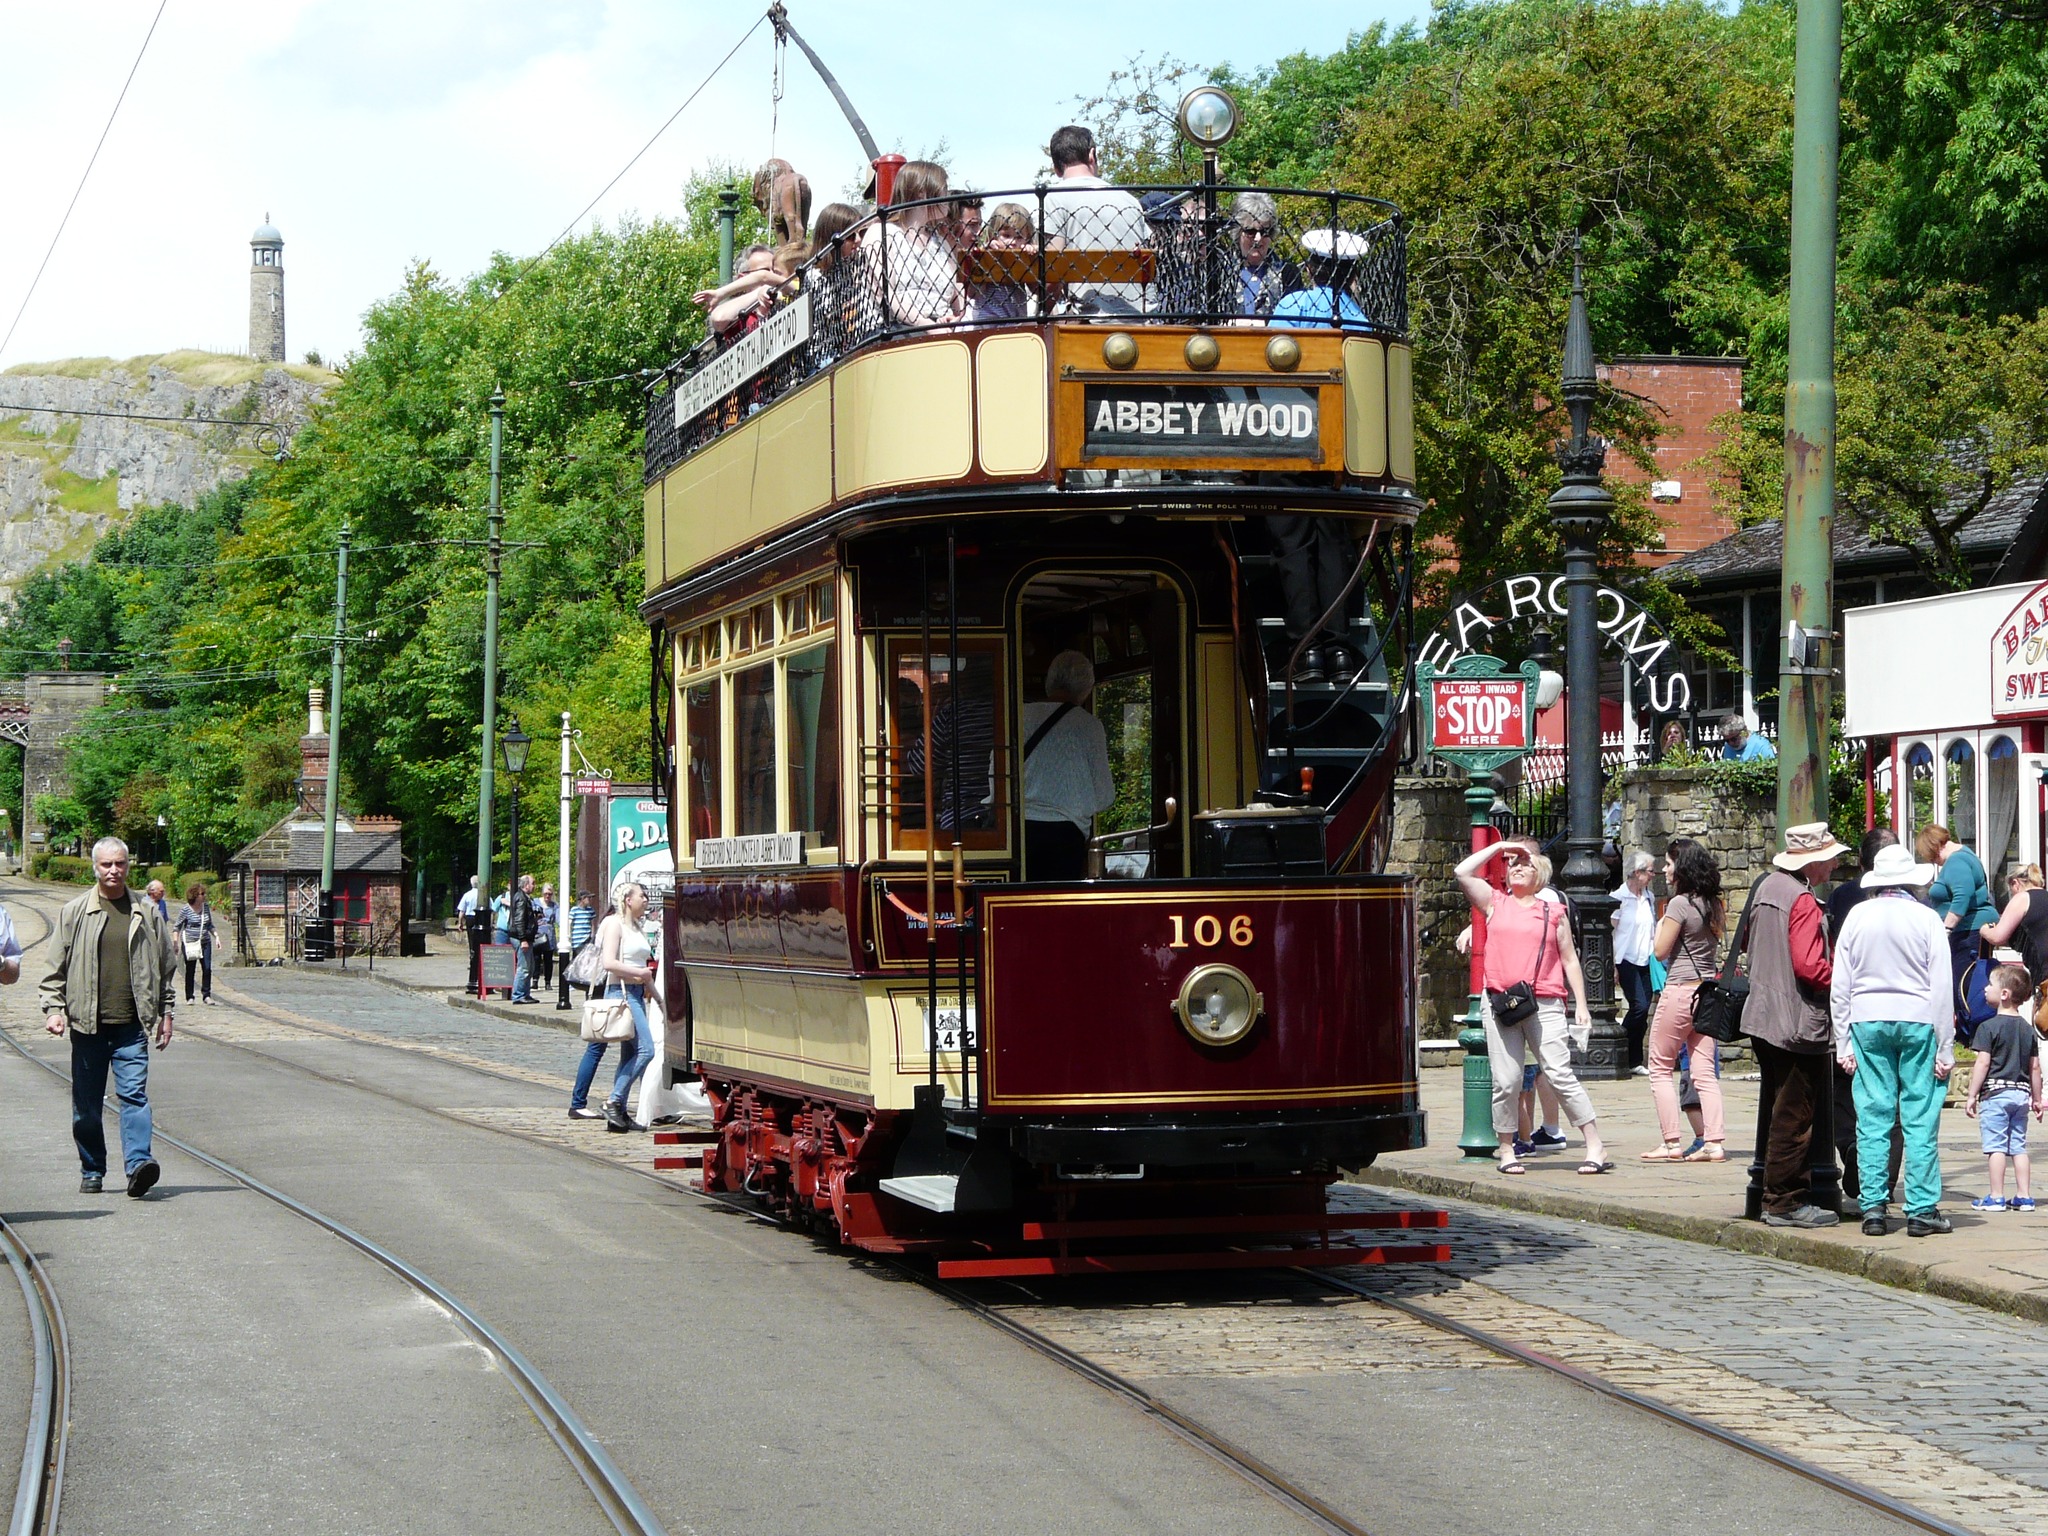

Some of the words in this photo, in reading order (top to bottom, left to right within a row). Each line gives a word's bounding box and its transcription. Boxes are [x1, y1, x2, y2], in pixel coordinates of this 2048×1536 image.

[760, 307, 797, 364] DARTFORD
[1093, 400, 1205, 434] ABBEY
[1216, 402, 1313, 438] WOOD
[1440, 685, 1456, 694] ALL
[1459, 685, 1481, 694] CARS
[1485, 685, 1518, 694] INWARD
[1446, 695, 1511, 735] STOP
[1460, 736, 1499, 744] HERE
[761, 836, 776, 863] ABBEY
[778, 834, 793, 862] WOOD
[1169, 915, 1253, 947] 106
